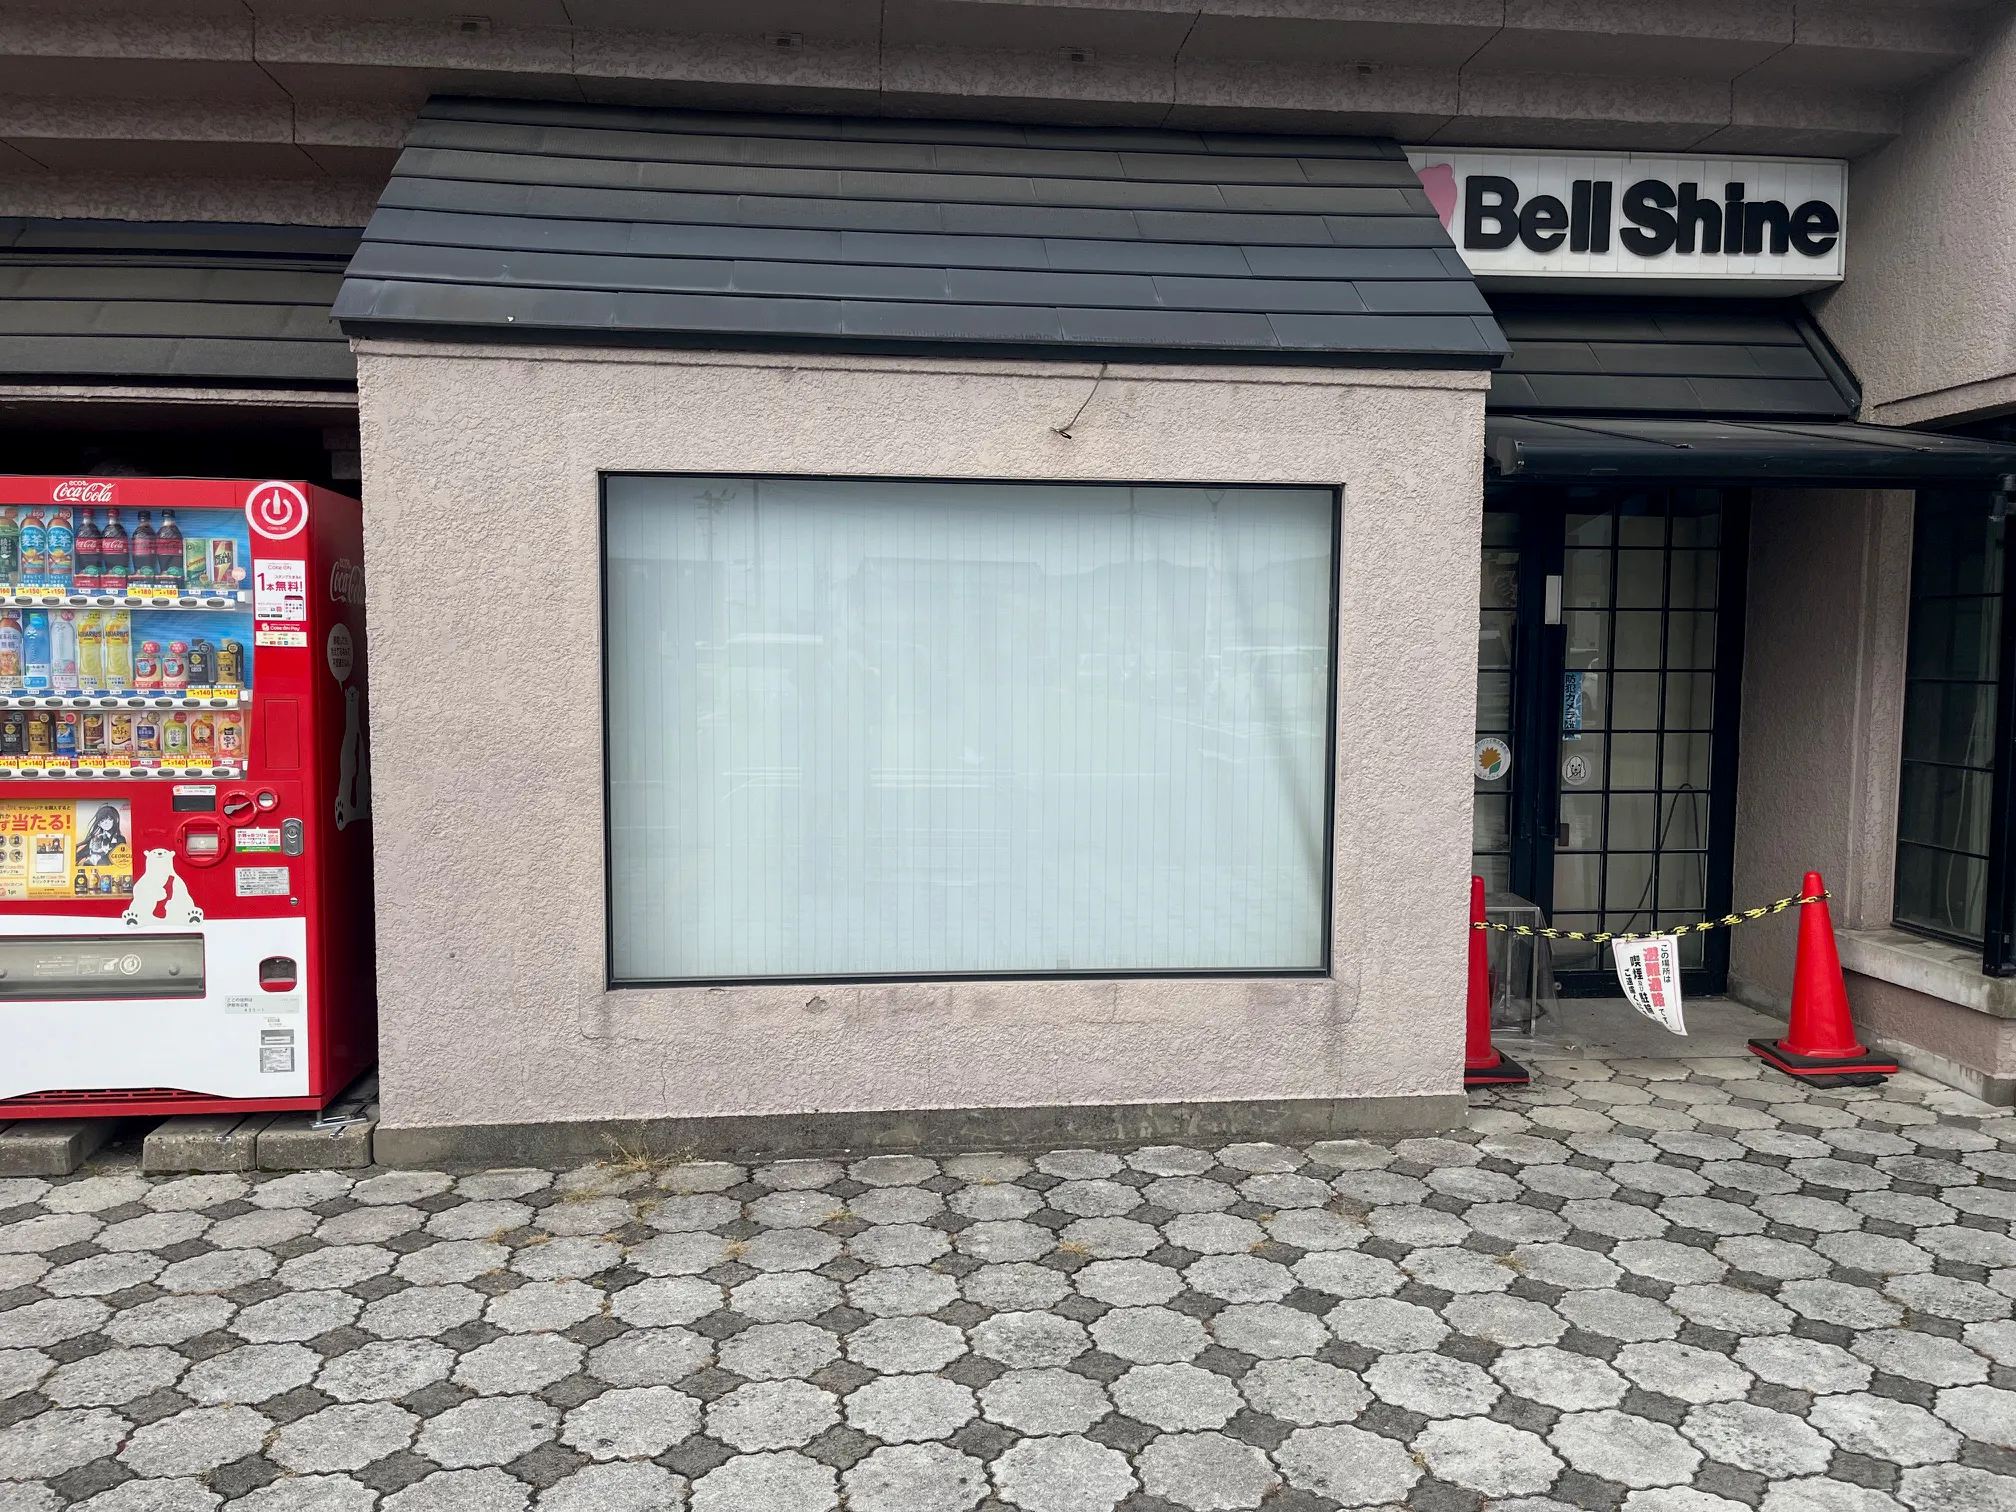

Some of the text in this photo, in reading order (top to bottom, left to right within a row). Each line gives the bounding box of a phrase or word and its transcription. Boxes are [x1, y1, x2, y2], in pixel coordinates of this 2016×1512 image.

[1463, 175, 1839, 256] Bell Shine
[53, 482, 116, 502] Coca-Cola
[22, 535, 44, 547] 麦茶
[49, 535, 71, 547] 麦茶
[1660, 944, 1671, 984] この場所は
